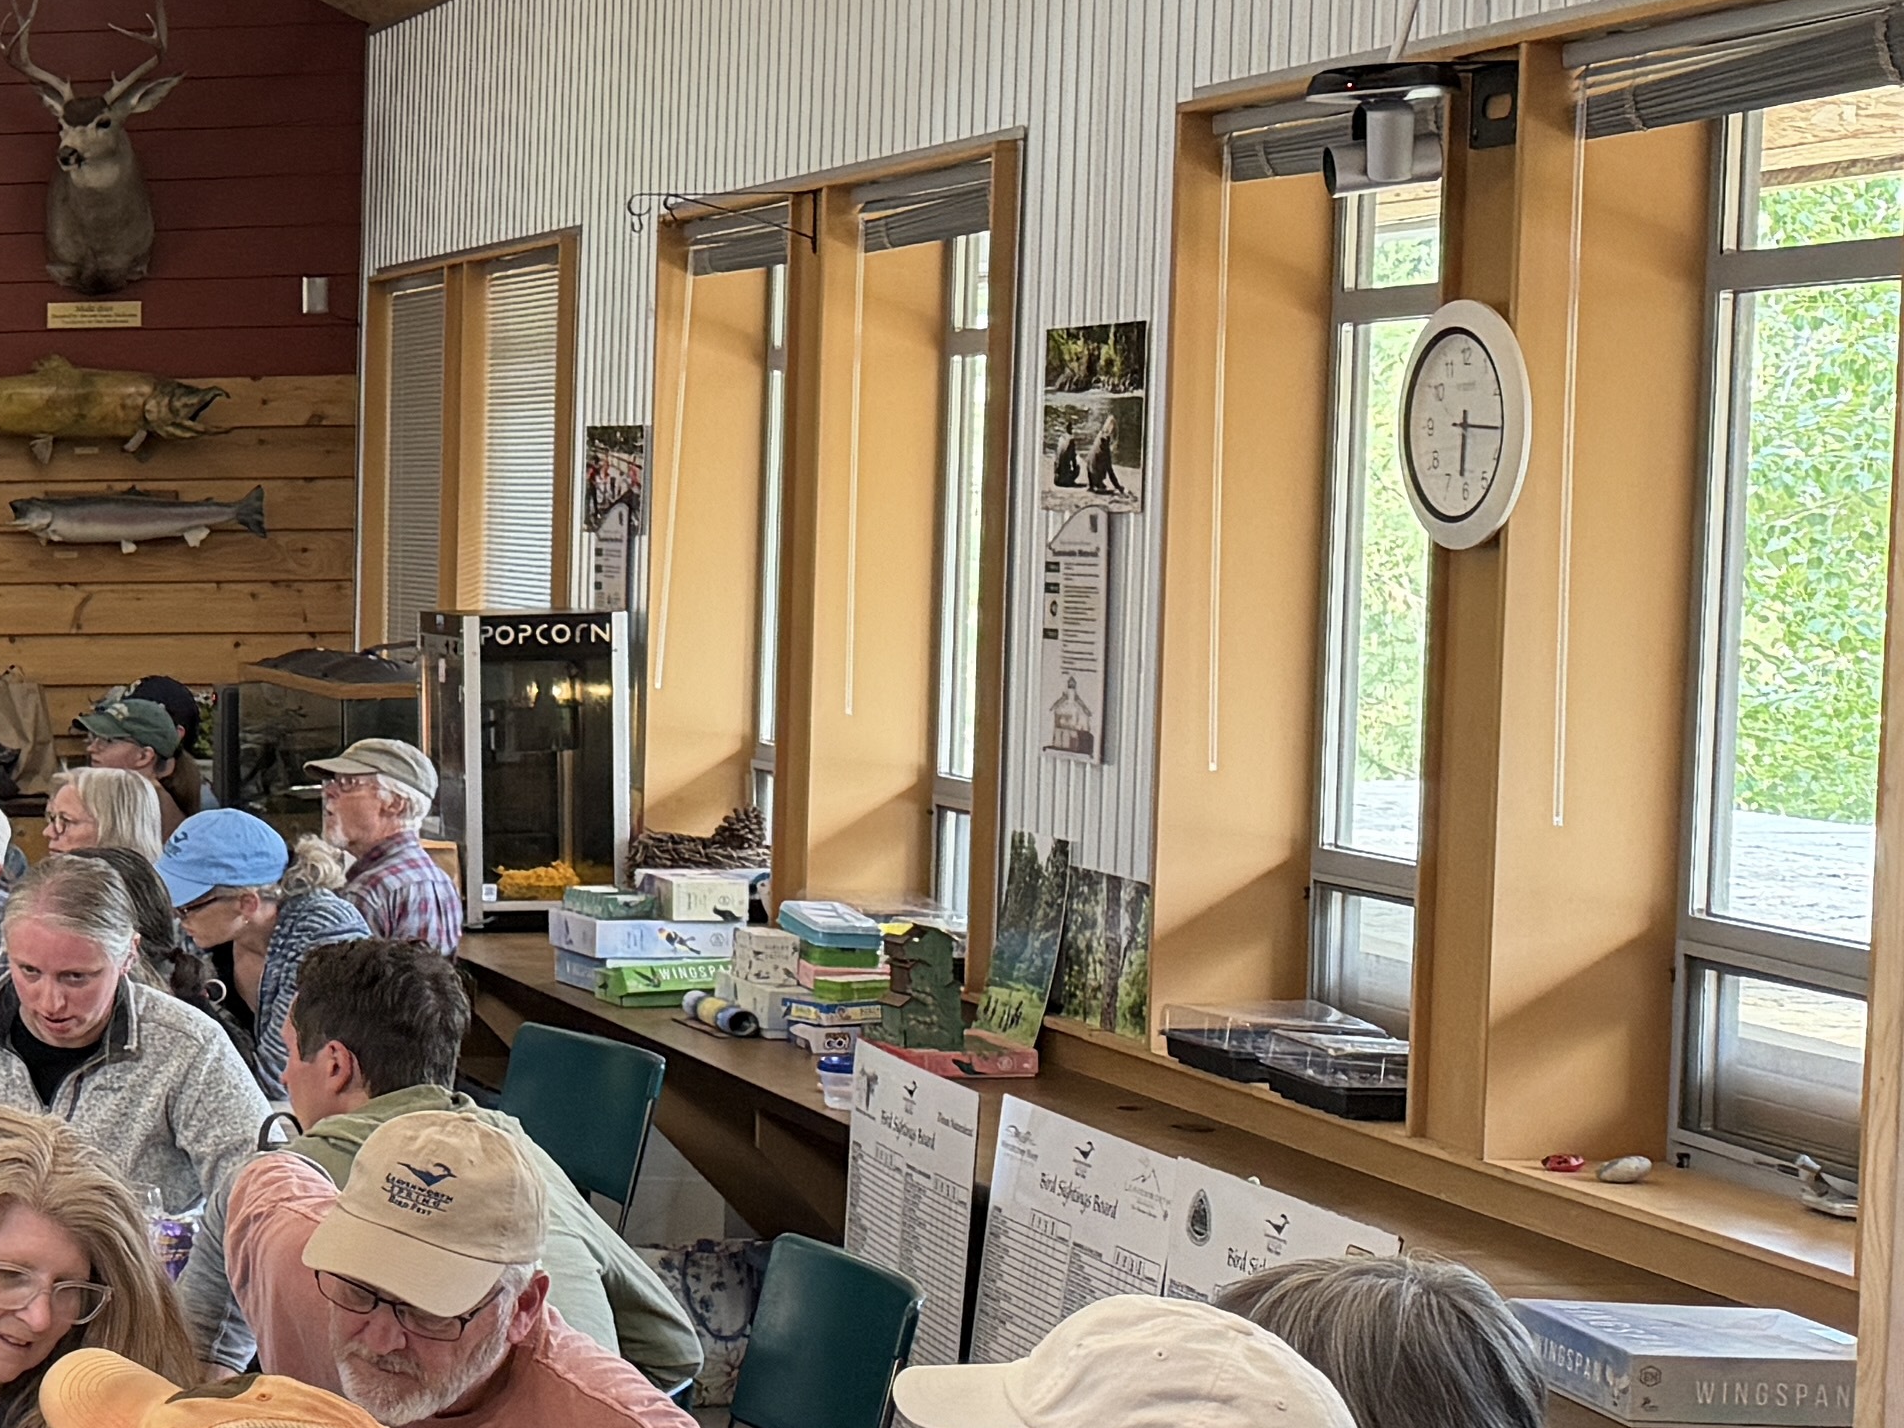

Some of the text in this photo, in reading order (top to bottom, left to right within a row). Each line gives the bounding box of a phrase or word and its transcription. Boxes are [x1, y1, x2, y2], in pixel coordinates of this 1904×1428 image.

[1434, 383, 1445, 401] 10
[1427, 418, 1434, 436] 9
[1432, 450, 1439, 470] 8
[481, 624, 610, 645] POPCORN
[1541, 1337, 1602, 1384] INGSPAN
[1695, 1380, 1850, 1408] WINGSPAN
